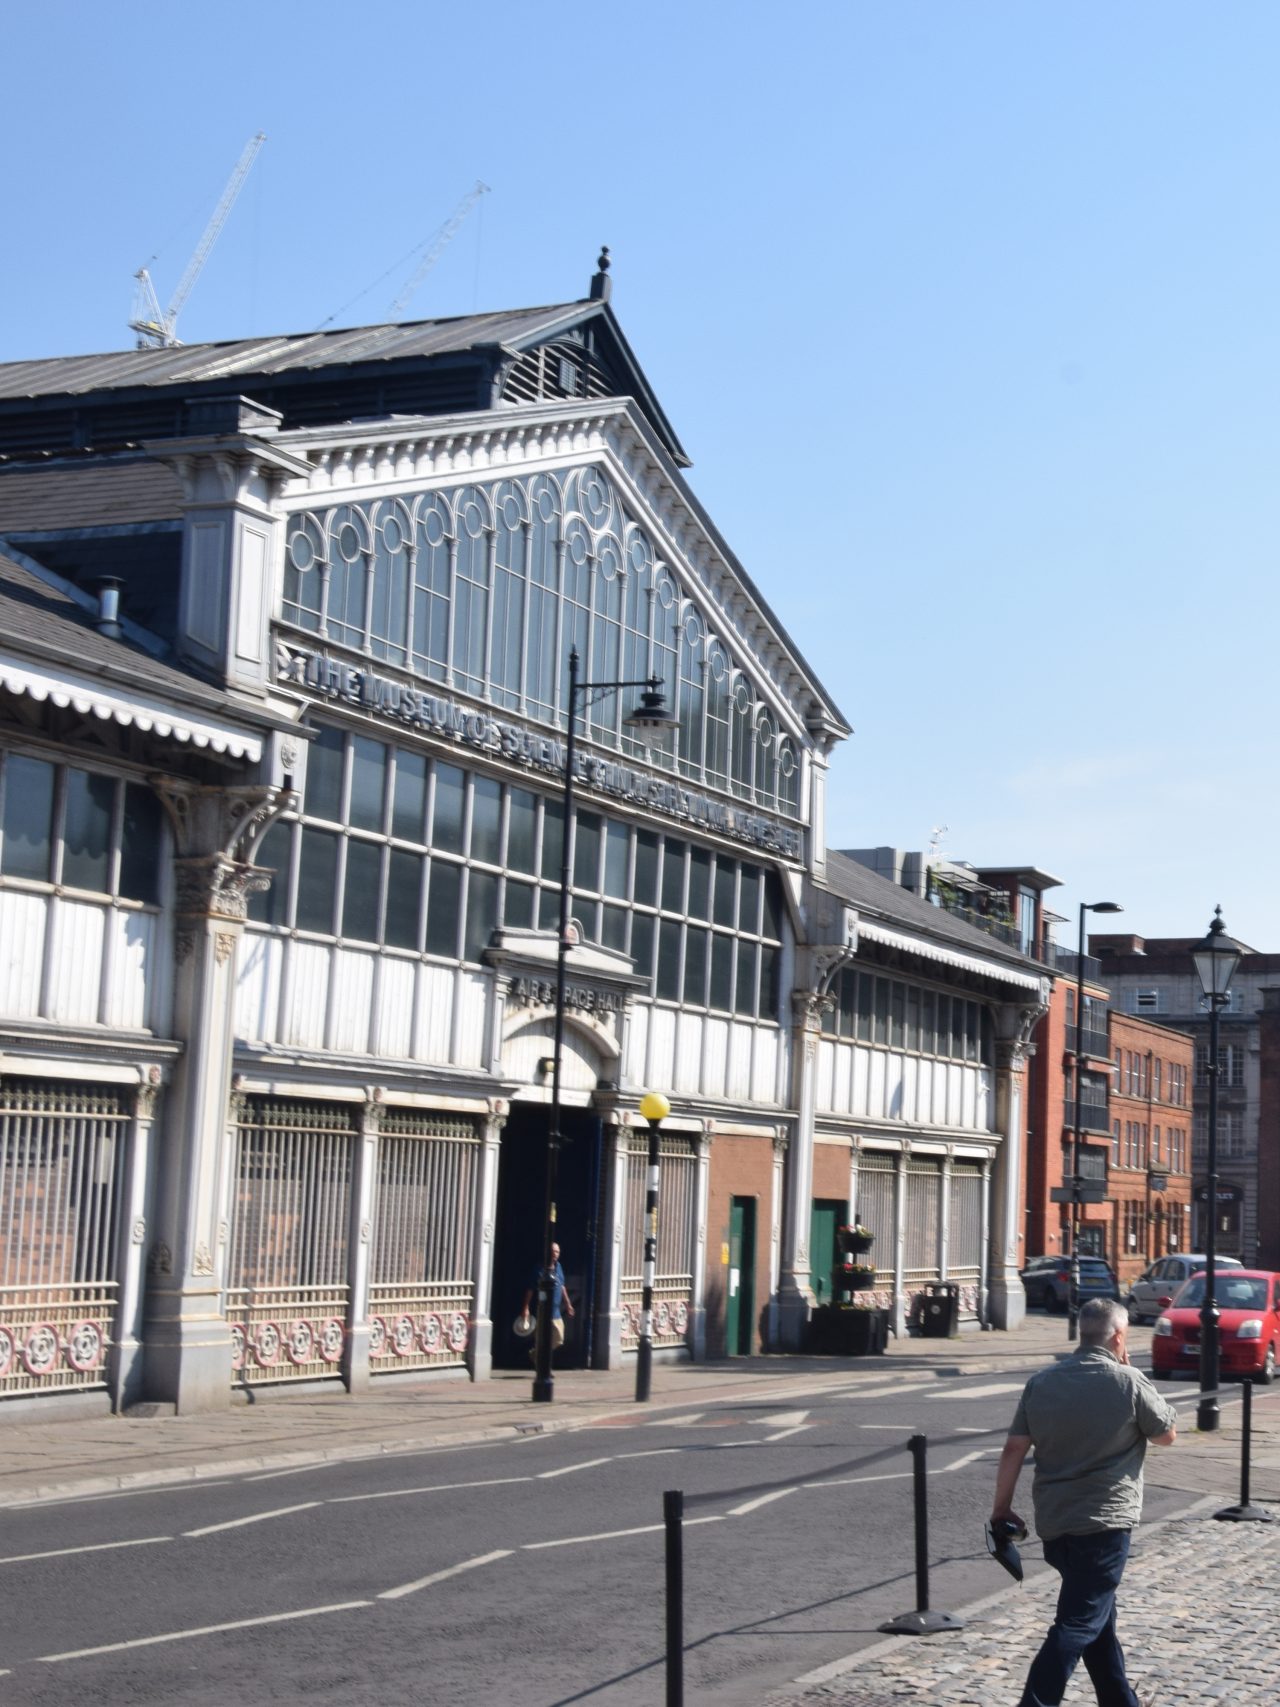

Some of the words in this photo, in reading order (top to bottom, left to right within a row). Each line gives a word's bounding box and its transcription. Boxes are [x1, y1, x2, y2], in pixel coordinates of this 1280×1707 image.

[306, 651, 361, 702] THE
[364, 672, 465, 737] MUSEUM
[501, 725, 588, 783] SCIENE
[518, 977, 540, 999] AIR
[543, 981, 552, 1000] &
[563, 986, 594, 1009] PACE
[598, 991, 625, 1013] HALL
